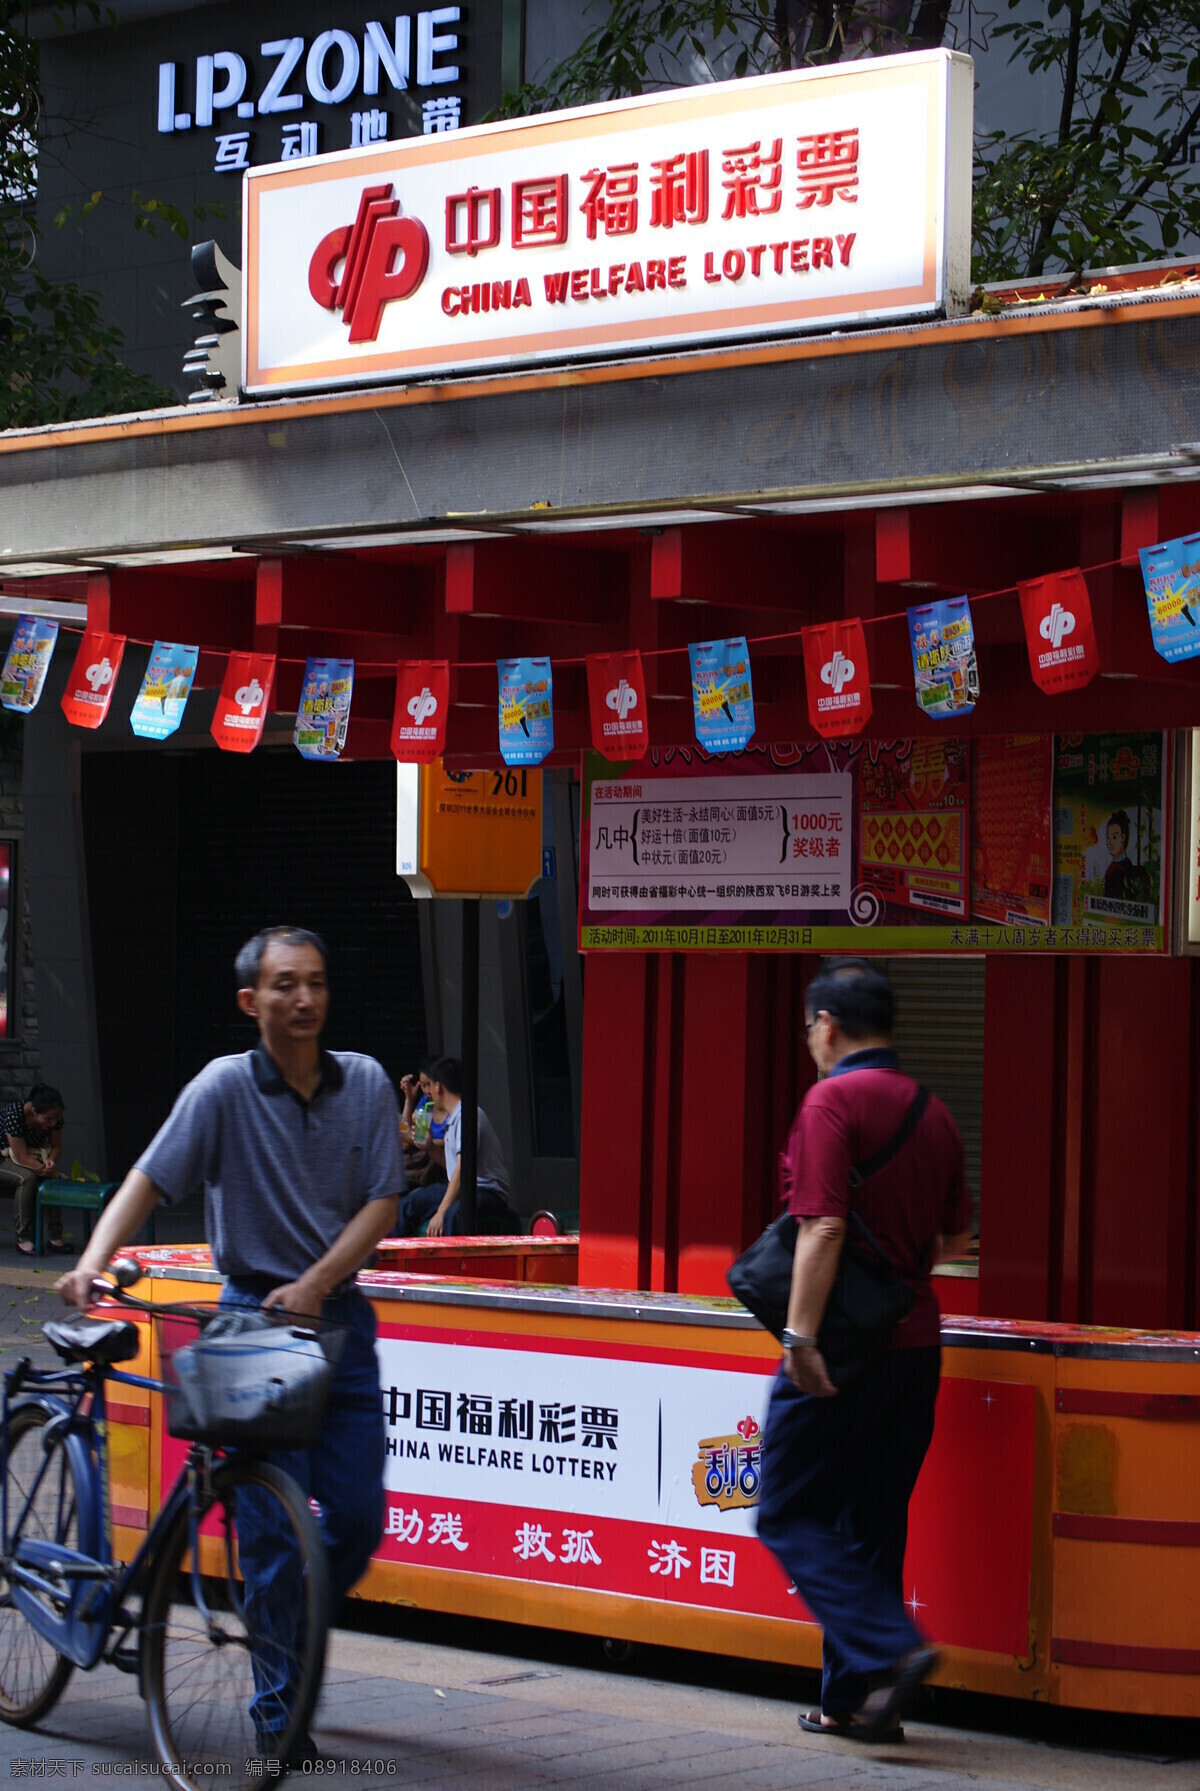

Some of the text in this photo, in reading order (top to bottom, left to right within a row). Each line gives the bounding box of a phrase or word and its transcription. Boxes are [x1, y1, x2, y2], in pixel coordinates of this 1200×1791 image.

[445, 127, 859, 257] 中国福利彩票
[441, 233, 857, 317] CHINA WELFARE LOTTERY
[594, 785, 642, 799] 在活动期间
[595, 824, 630, 850] 凡中
[792, 812, 843, 832] 1000元
[793, 836, 841, 858] 奖级者
[950, 927, 1156, 946] 未满十八周岁者不得购买彩票
[383, 1386, 618, 1450] 中国福利彩票
[385, 1437, 617, 1482] HINA WELFARE LOTTERY
[384, 1506, 736, 1588] 助残 救孤 济困
